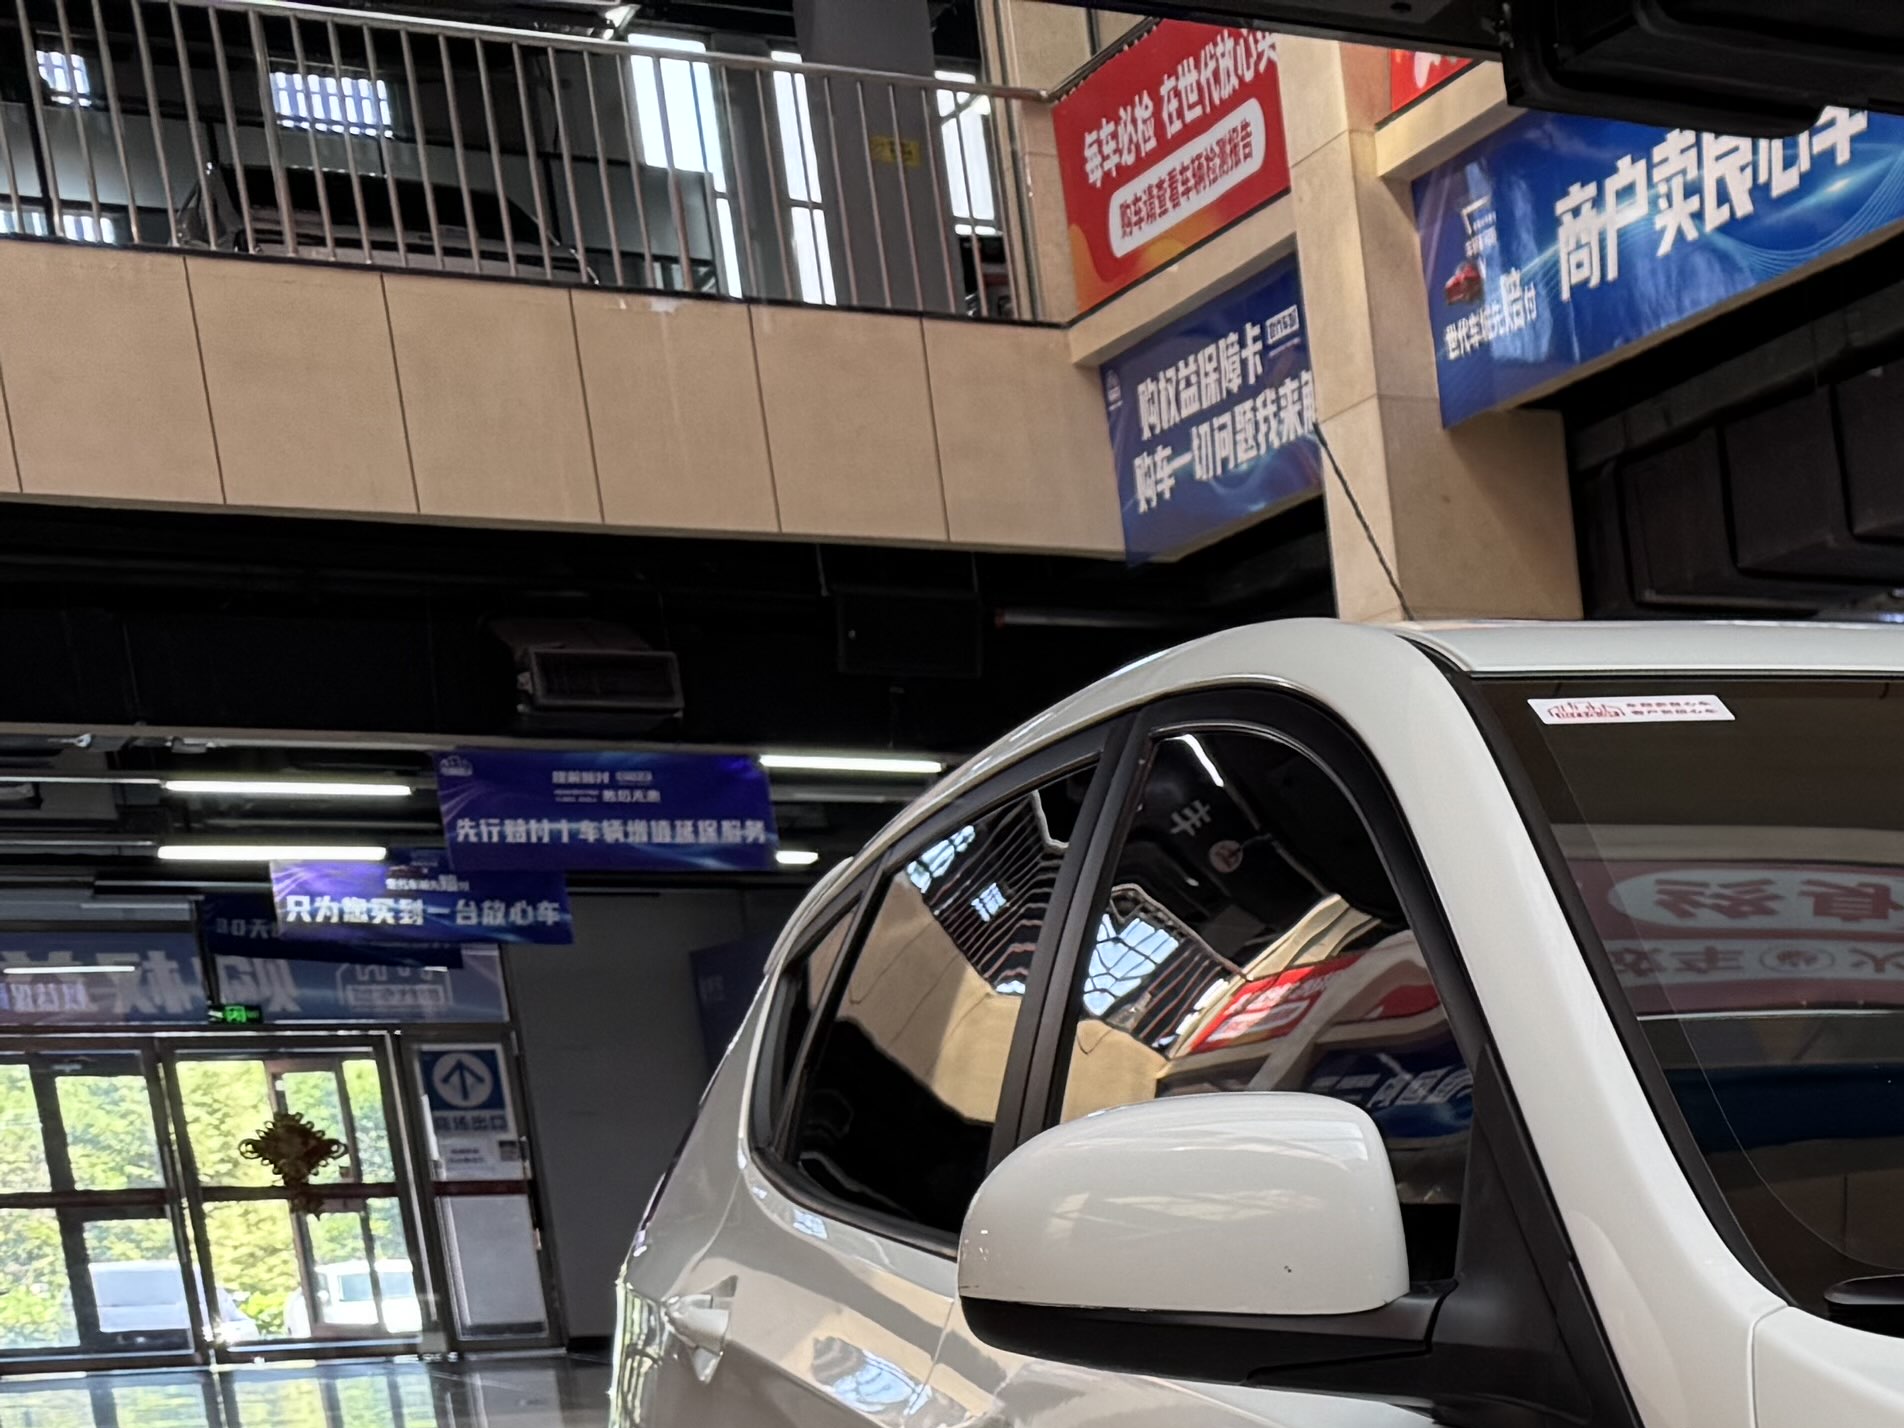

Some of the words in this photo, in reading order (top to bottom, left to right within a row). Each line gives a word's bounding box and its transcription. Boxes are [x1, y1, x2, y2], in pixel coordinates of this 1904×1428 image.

[1083, 89, 1158, 188] 每车必检
[1554, 105, 1869, 302] 商户卖良心车
[1136, 321, 1263, 442] 购权益保障卡
[285, 893, 561, 928] 只为您买到一台放心车
